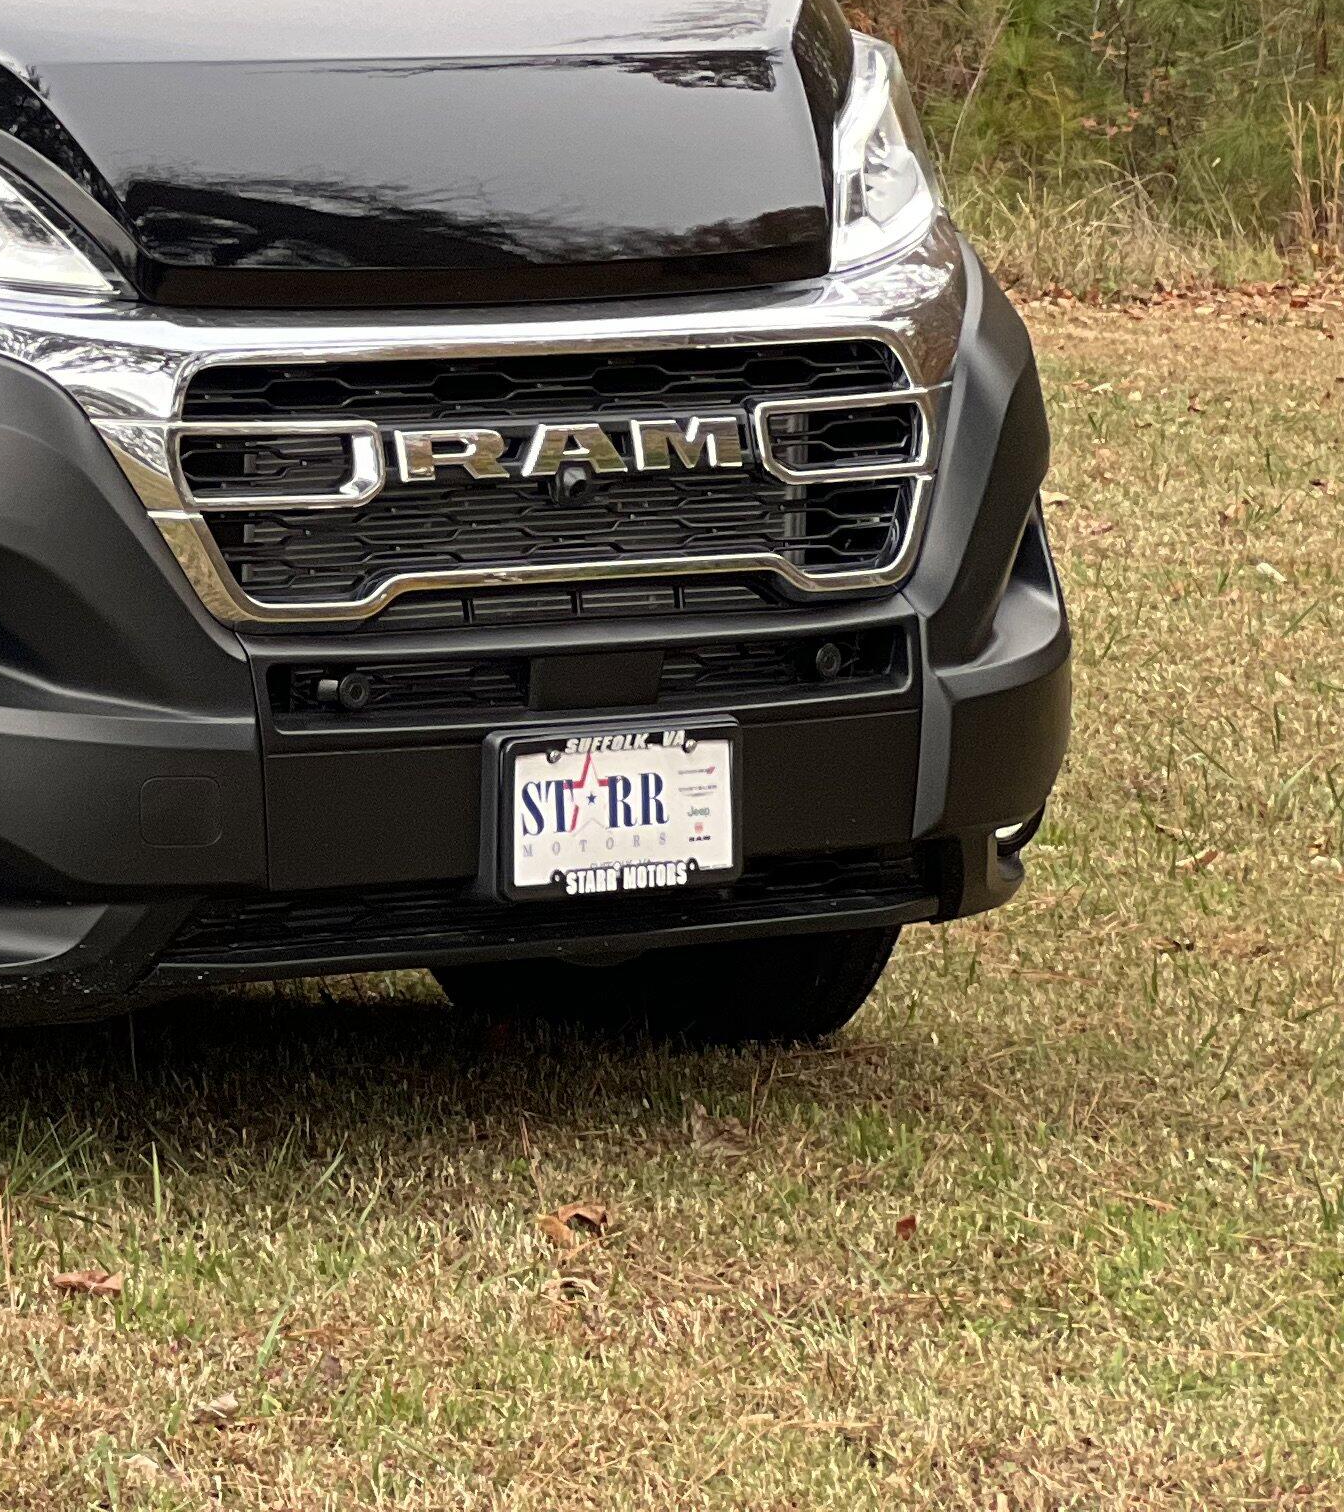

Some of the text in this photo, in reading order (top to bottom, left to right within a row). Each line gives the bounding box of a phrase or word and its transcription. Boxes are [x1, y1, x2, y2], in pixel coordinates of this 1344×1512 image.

[394, 417, 742, 483] RAM
[662, 730, 686, 747] VA
[523, 832, 666, 857] MOTORS
[623, 861, 687, 890] MOTORS
